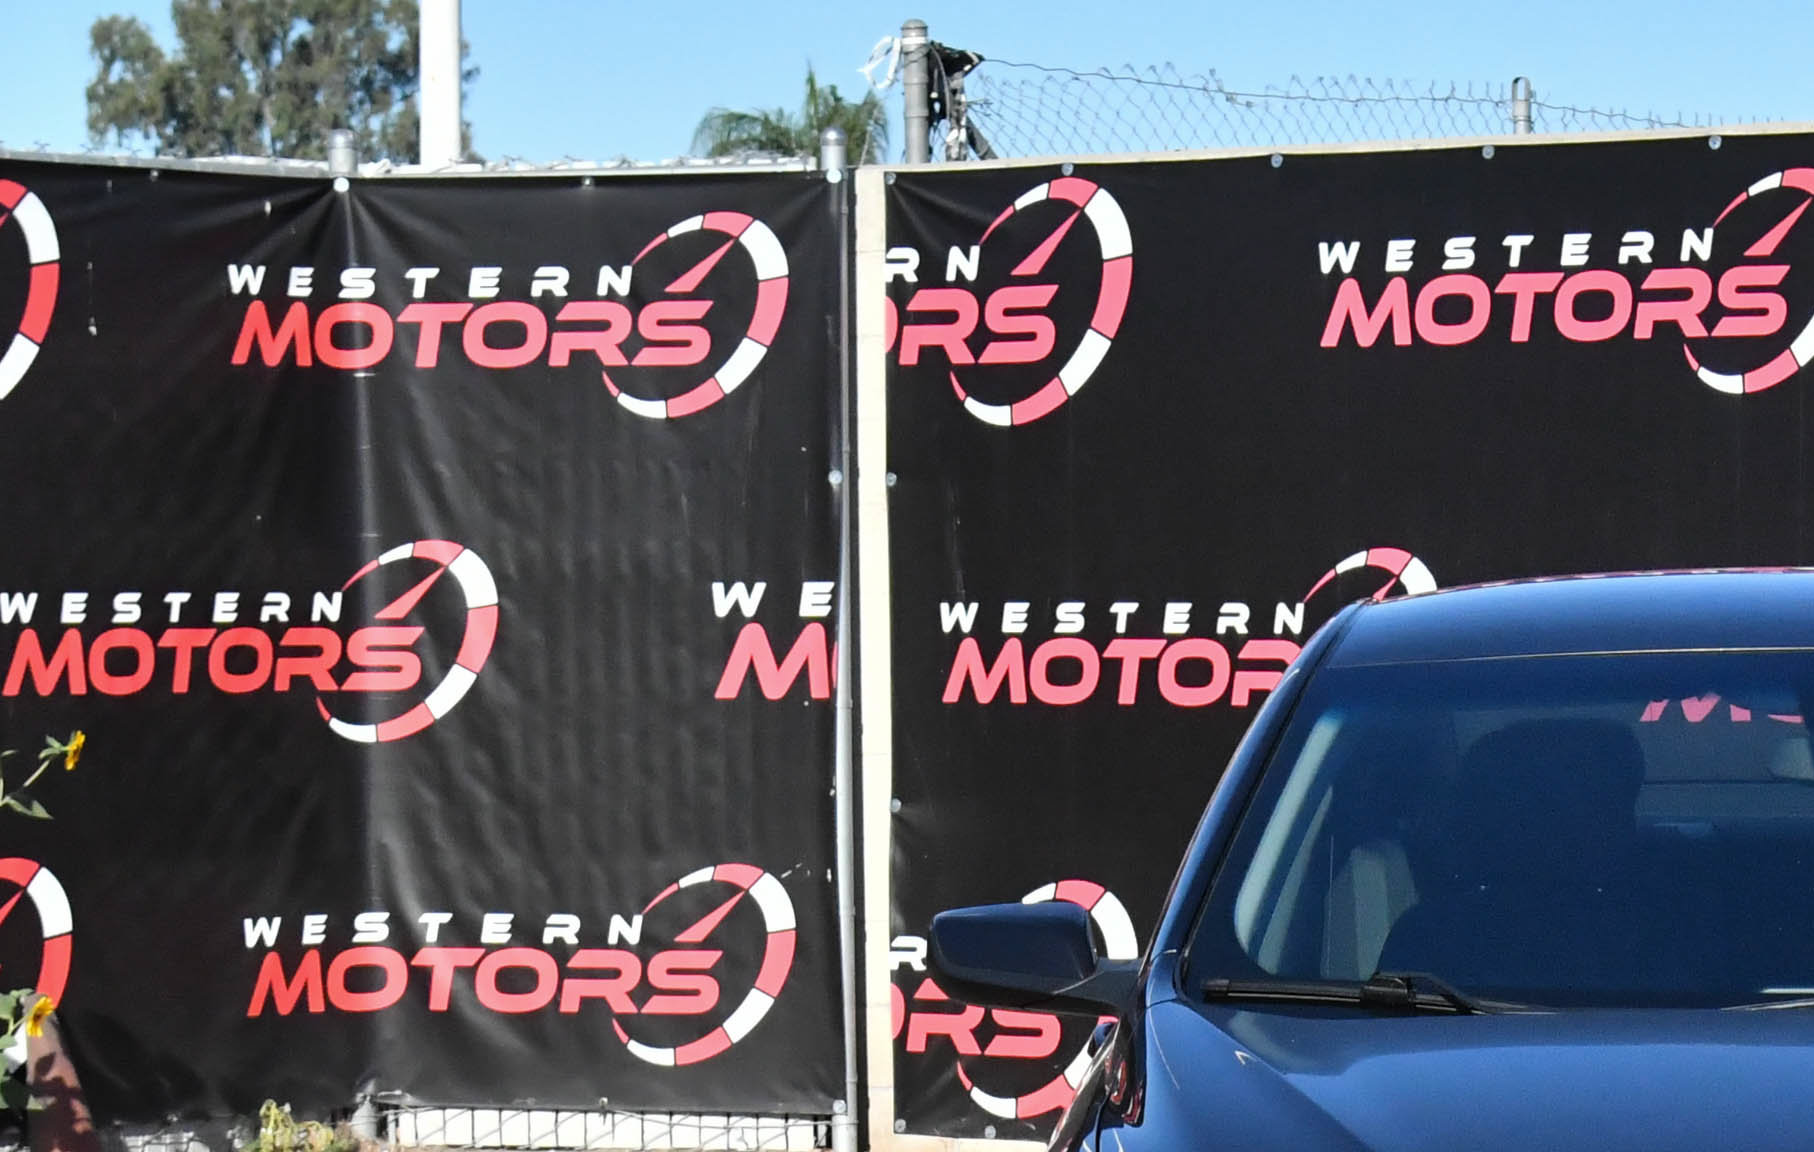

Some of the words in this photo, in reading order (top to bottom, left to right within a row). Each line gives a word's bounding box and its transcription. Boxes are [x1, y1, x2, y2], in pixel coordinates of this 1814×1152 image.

[1318, 227, 1715, 275] WESTERN
[227, 263, 633, 300] WESTERN
[1319, 264, 1791, 348] MOTORS
[231, 299, 715, 370] MOTORS
[885, 284, 1060, 366] RS
[0, 591, 344, 624] WESTERN
[939, 601, 1306, 635] WESTERN
[1, 625, 425, 698] MOTORS
[243, 911, 644, 947] WESTERN
[247, 945, 725, 1017] MOTORS
